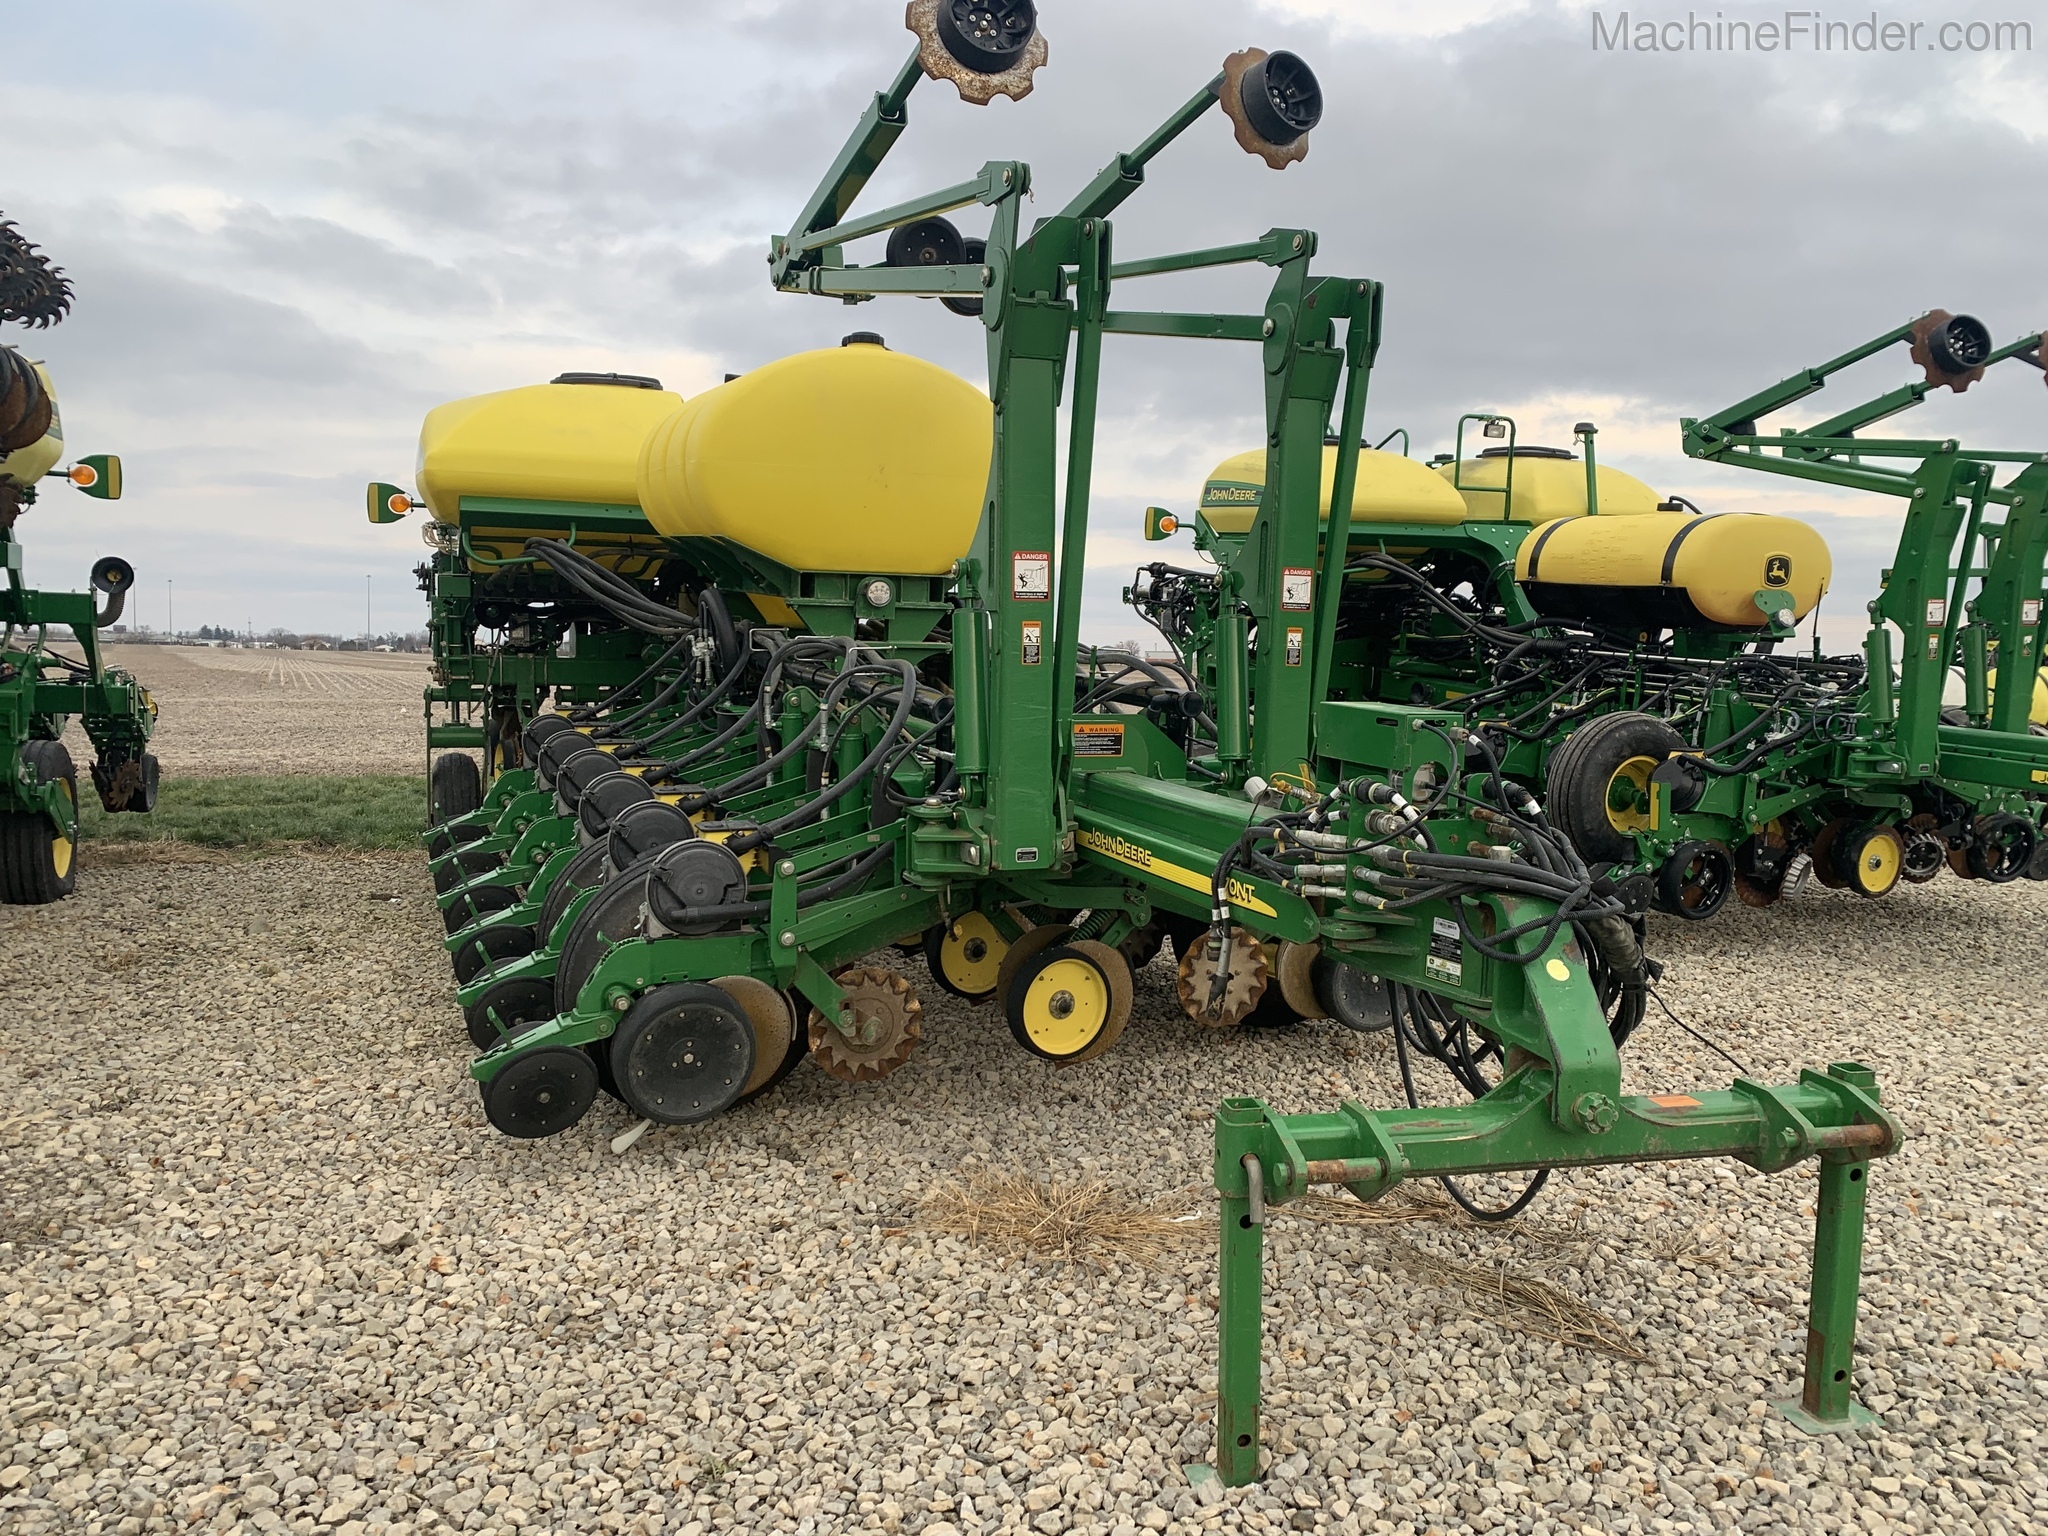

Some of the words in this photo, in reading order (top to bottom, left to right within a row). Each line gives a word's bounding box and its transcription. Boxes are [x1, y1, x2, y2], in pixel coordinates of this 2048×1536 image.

[1207, 487, 1228, 501] JOHN
[1228, 487, 1256, 501] DEERE
[1088, 827, 1116, 853] JOHN
[1116, 836, 1152, 867] DEERE
